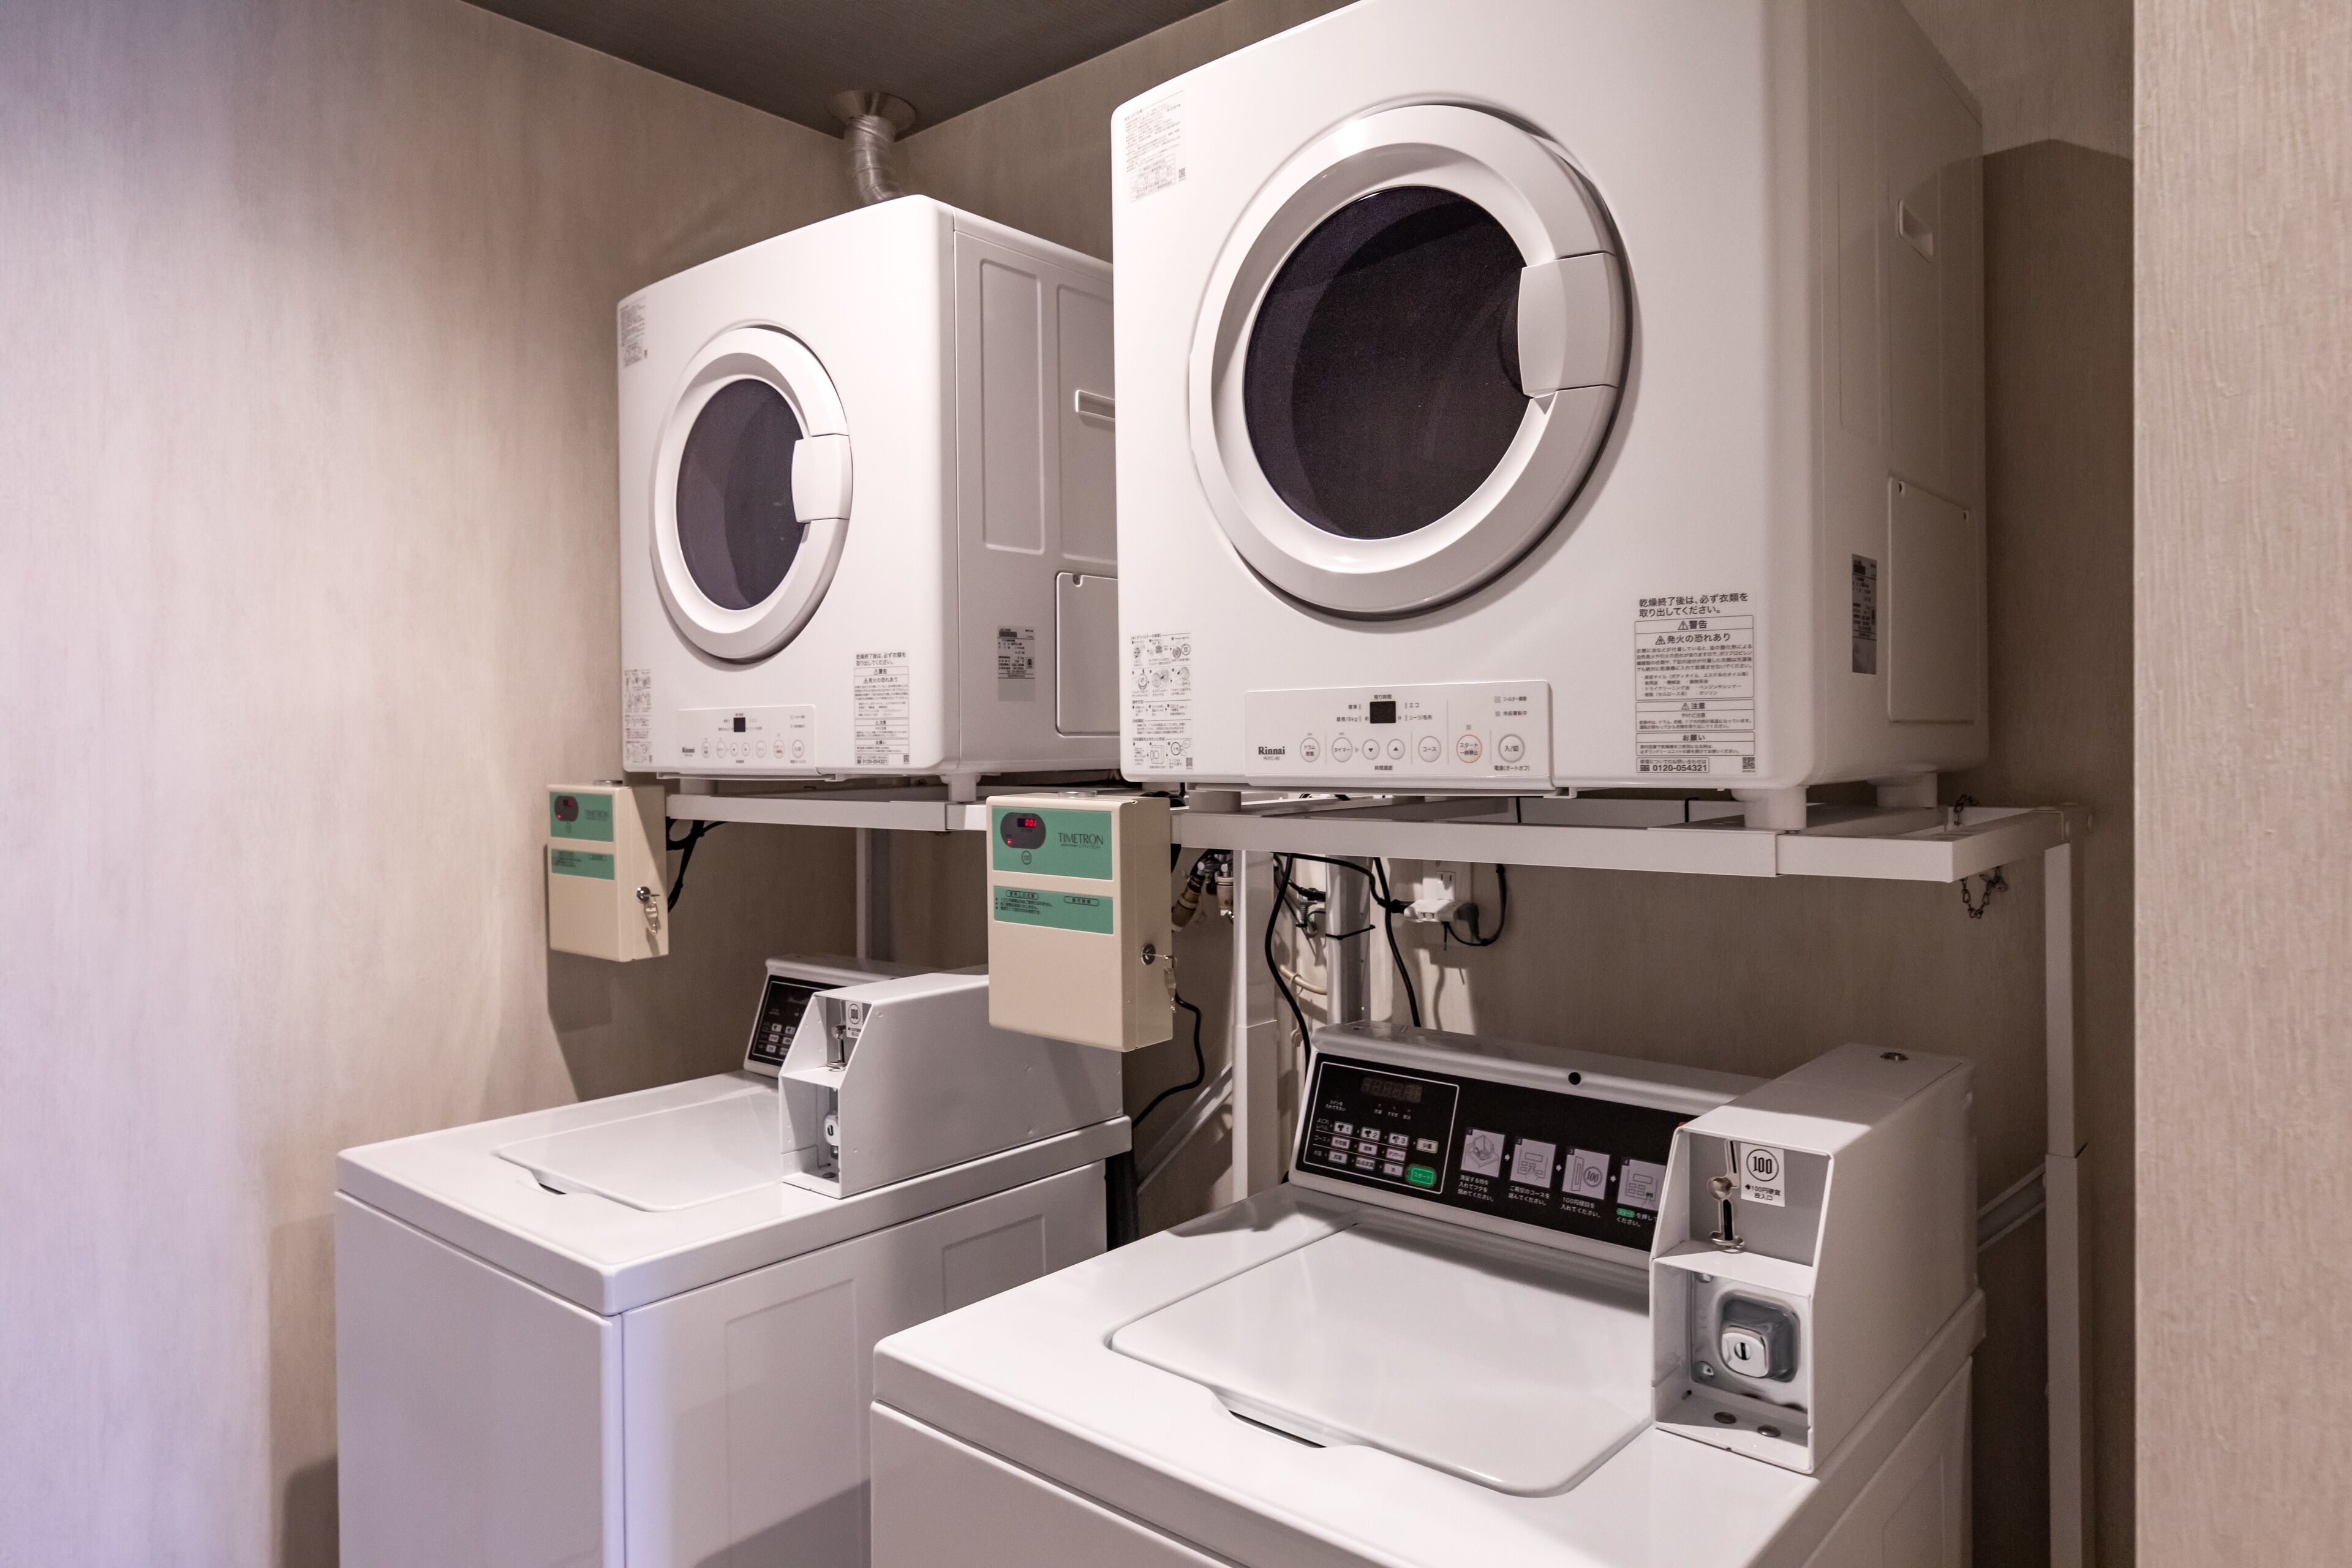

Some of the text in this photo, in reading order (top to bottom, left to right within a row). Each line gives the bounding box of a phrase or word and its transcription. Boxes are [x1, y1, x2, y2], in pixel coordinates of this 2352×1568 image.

[1639, 593, 1748, 607] 乾燥終了後は、必ず衣類を
[1639, 605, 1721, 617] 取り出してください。
[1689, 620, 1707, 629] 警告
[1667, 633, 1730, 644] 発火の恐れあり
[1258, 746, 1286, 755] Rinnai
[1058, 832, 1104, 845] TIMETRON
[1752, 1156, 1773, 1174] 100
[1413, 1171, 1431, 1180] スタート
[1586, 1170, 1599, 1183] 100
[1458, 1182, 1488, 1193] 入れてフタを
[1560, 1204, 1600, 1218] 入れてください。
[1616, 1217, 1642, 1227] ください。
